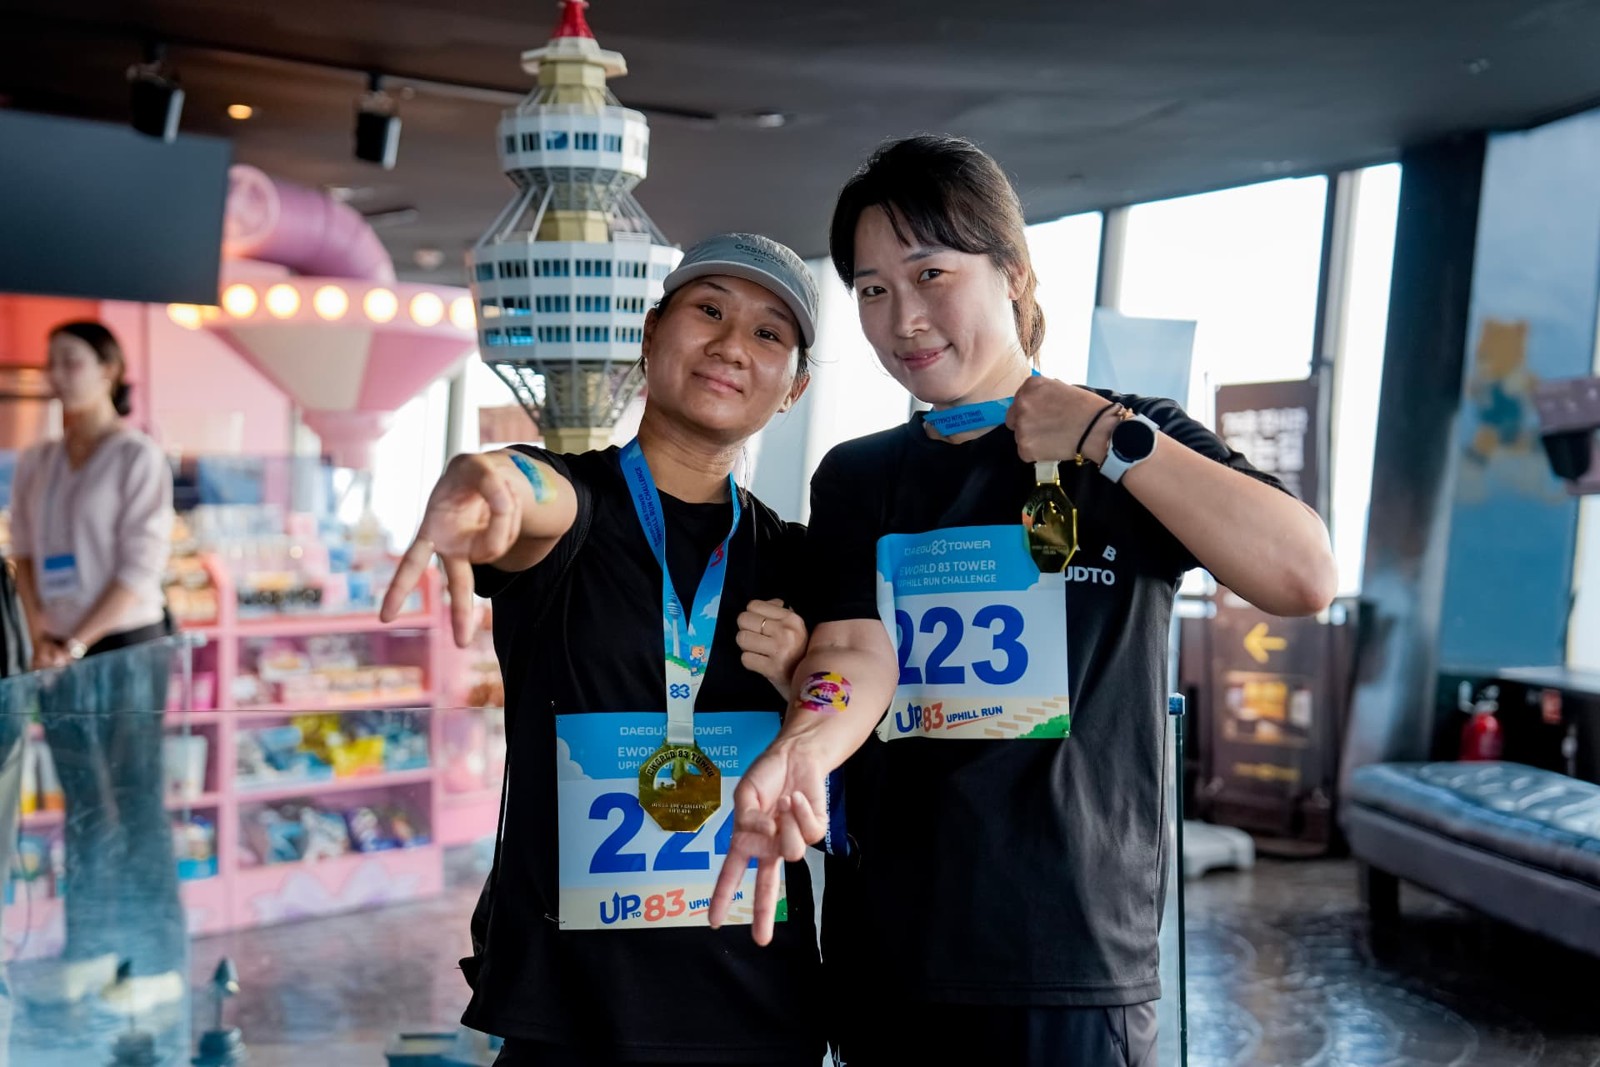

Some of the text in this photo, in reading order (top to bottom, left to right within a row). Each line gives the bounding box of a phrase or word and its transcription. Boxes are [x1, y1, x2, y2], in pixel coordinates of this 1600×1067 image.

[900, 560, 996, 577] EWORLD 83 TOWER
[897, 574, 997, 588] UPHILL RUN CHALLENGE
[895, 604, 1029, 685] 223
[895, 701, 1003, 733] UP 83 UPHILL RUN
[620, 726, 732, 736] DAEGU OWER
[700, 746, 738, 756] OWER
[600, 891, 642, 925] UP
[631, 910, 642, 919] TO
[644, 888, 686, 922] 83
